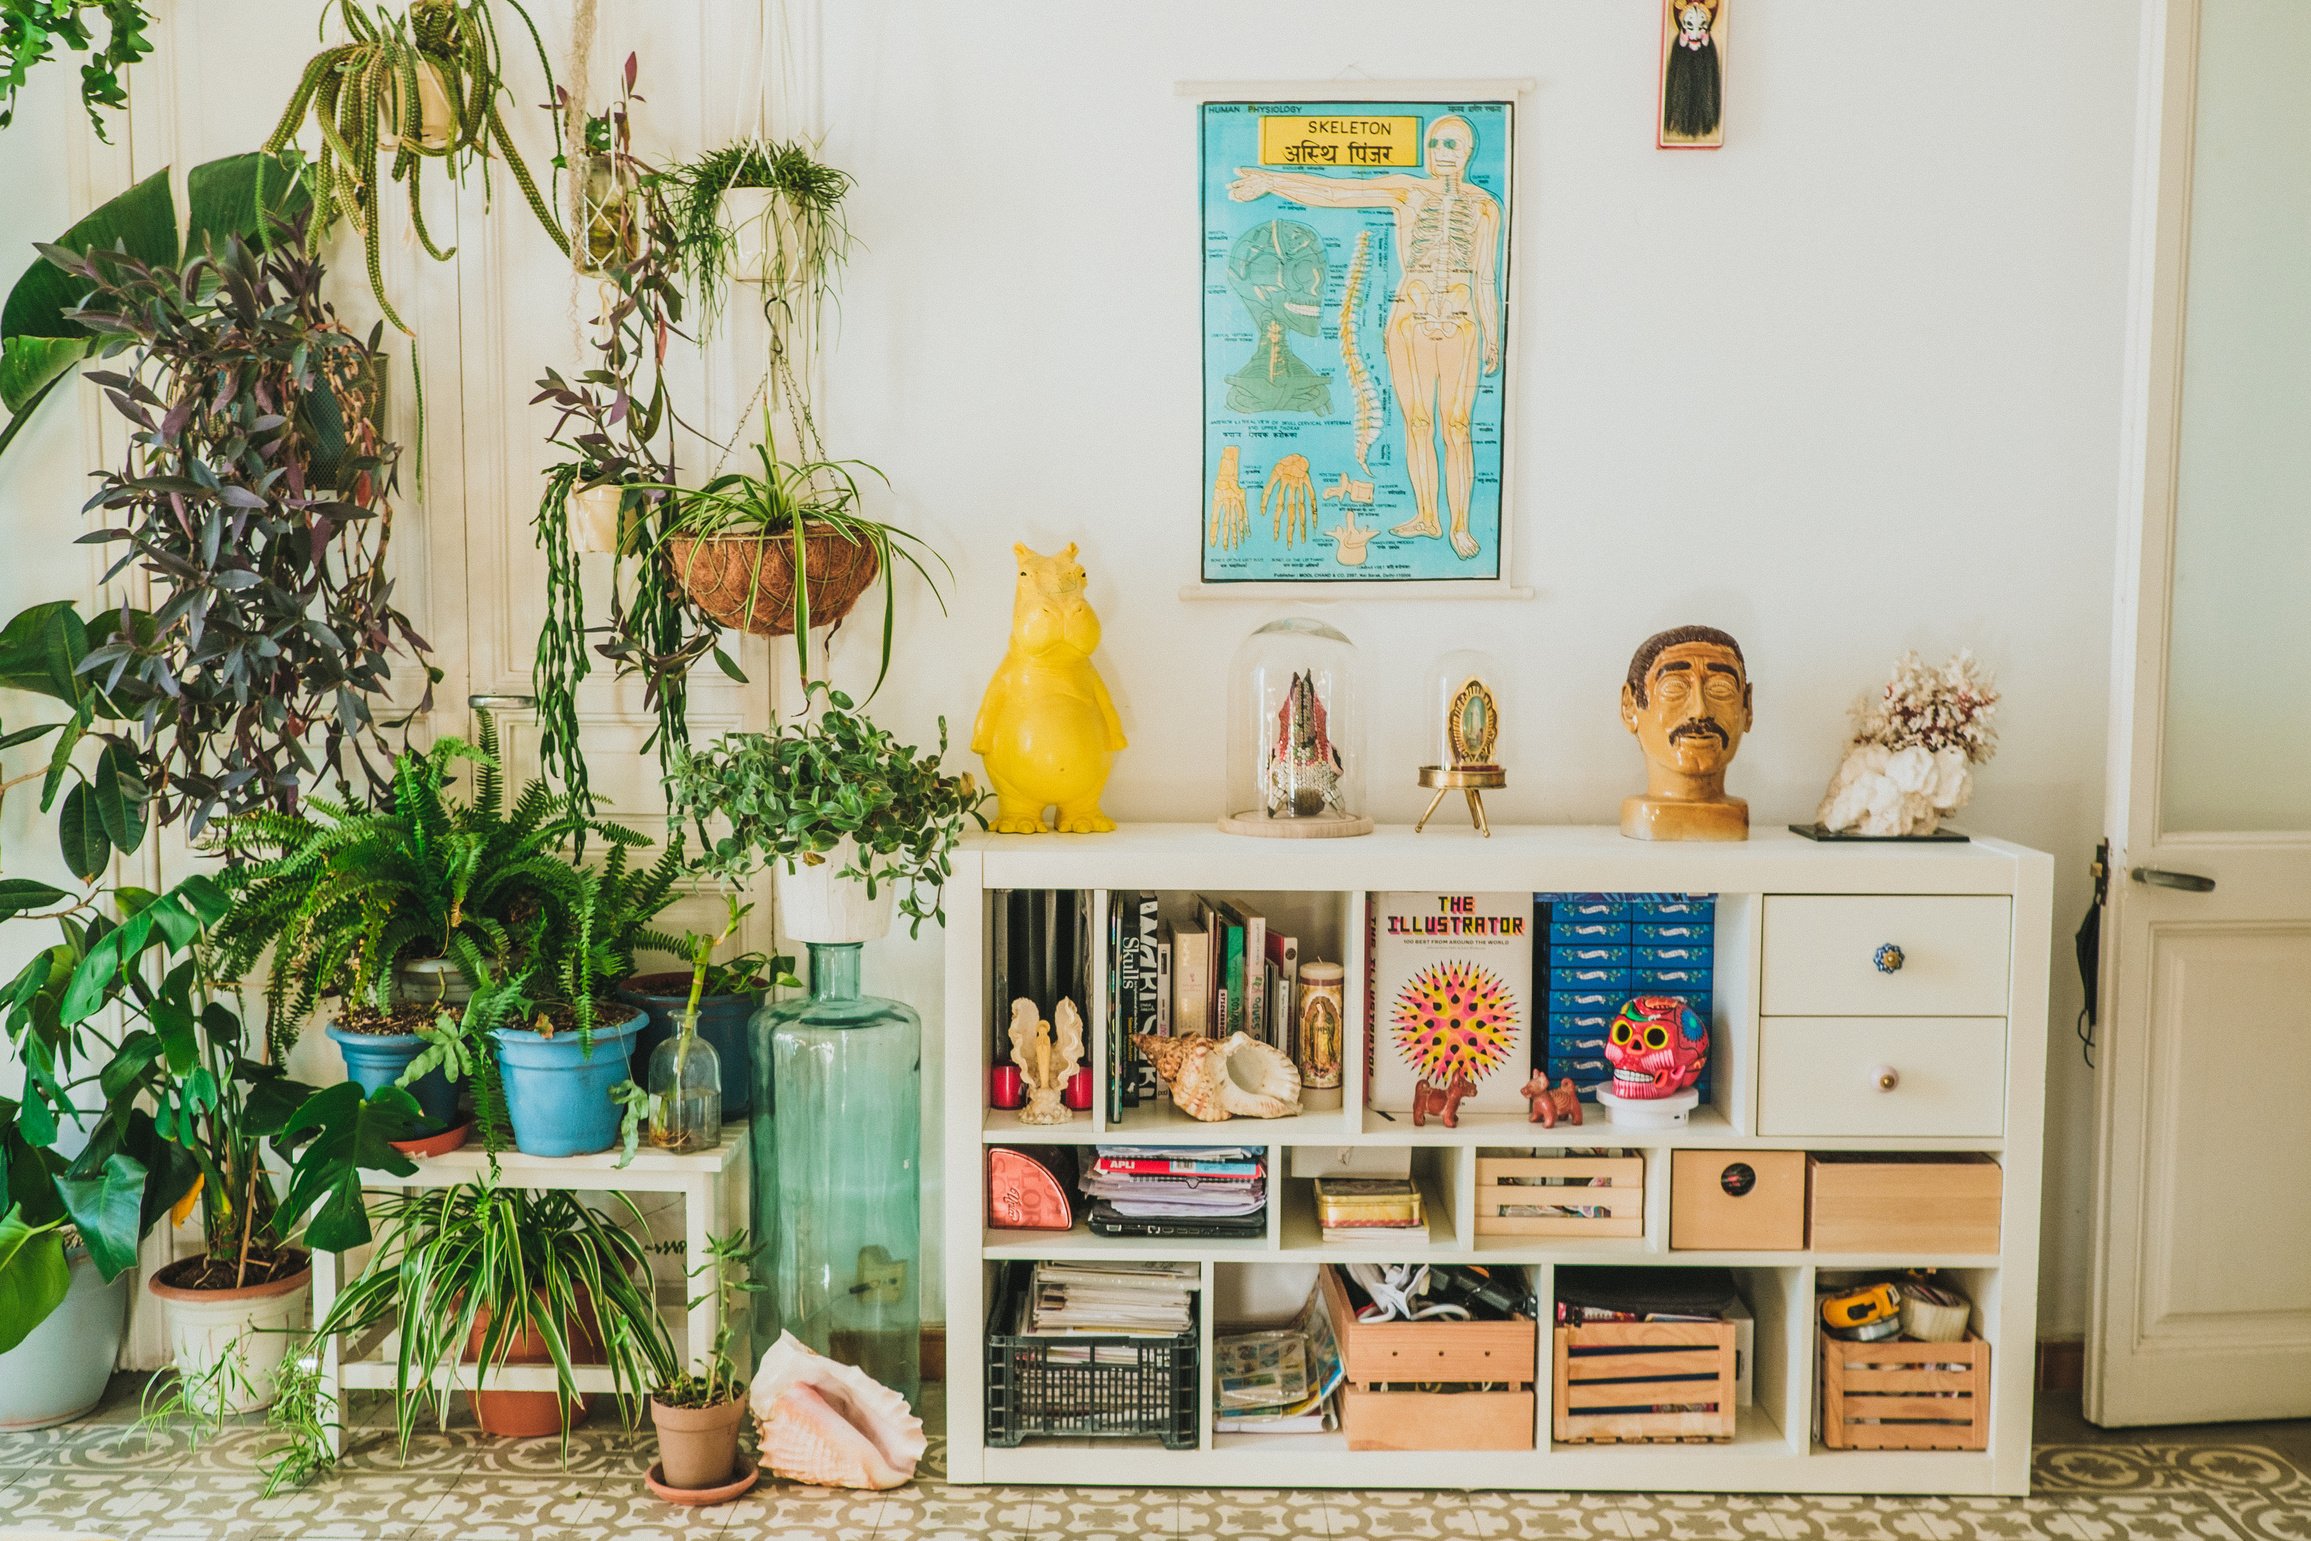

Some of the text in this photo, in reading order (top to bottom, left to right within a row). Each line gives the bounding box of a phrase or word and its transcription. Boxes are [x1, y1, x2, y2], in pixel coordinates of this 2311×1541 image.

[1208, 105, 1303, 114] HUMAN PHYSIOLOGY
[1307, 120, 1392, 136] SKELETON
[1283, 140, 1394, 165] अस्थि पिंजर
[1438, 896, 1475, 914] THE
[1387, 915, 1525, 935] ILLUSTRATOR
[1122, 936, 1140, 990] Skulls
[1368, 916, 1377, 1078] THE ILLUSTRATOR
[1109, 1160, 1136, 1169] APLI
